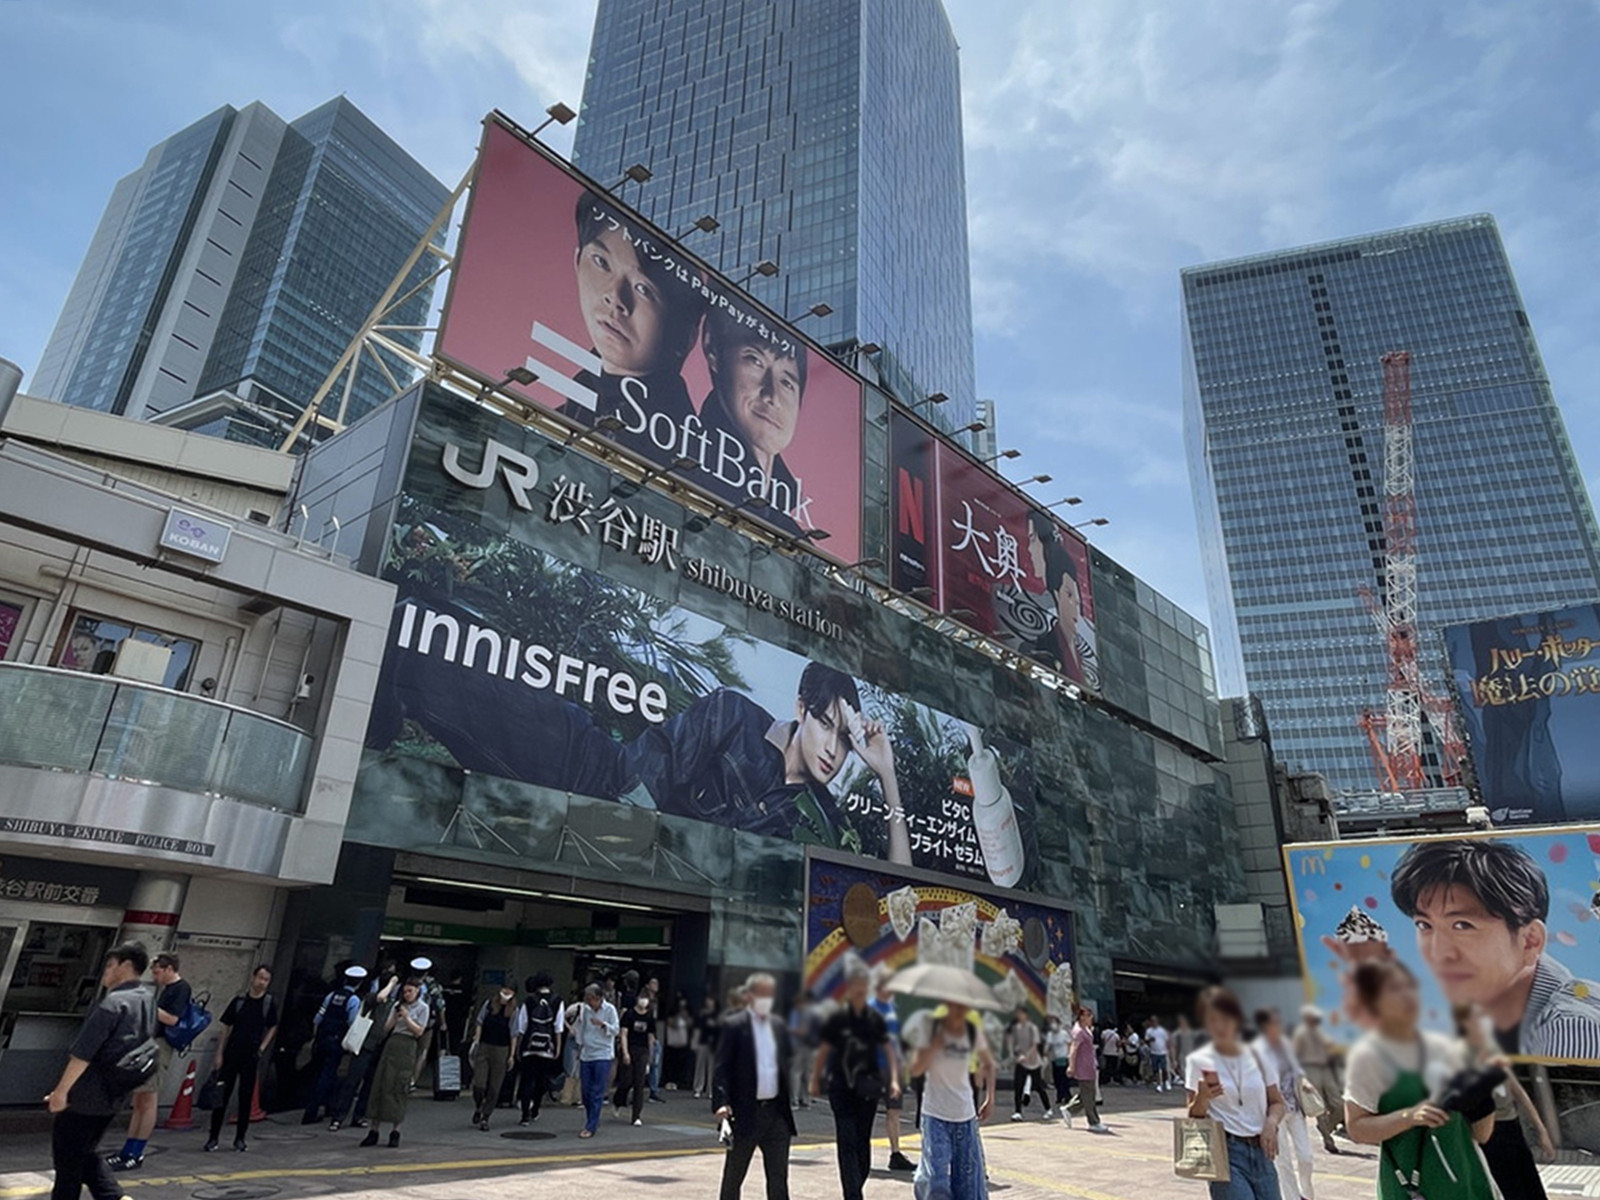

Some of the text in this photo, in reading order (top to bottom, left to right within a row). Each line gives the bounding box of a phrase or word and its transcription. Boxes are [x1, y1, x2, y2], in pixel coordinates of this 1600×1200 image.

[615, 376, 815, 530] SoftBank
[442, 437, 844, 641] JR 渋谷駅 shibuya station
[899, 467, 925, 545] N
[951, 500, 1028, 594] 大奥
[135, 834, 179, 851] POLICE
[847, 793, 977, 845] グリーンティーエンザイム
